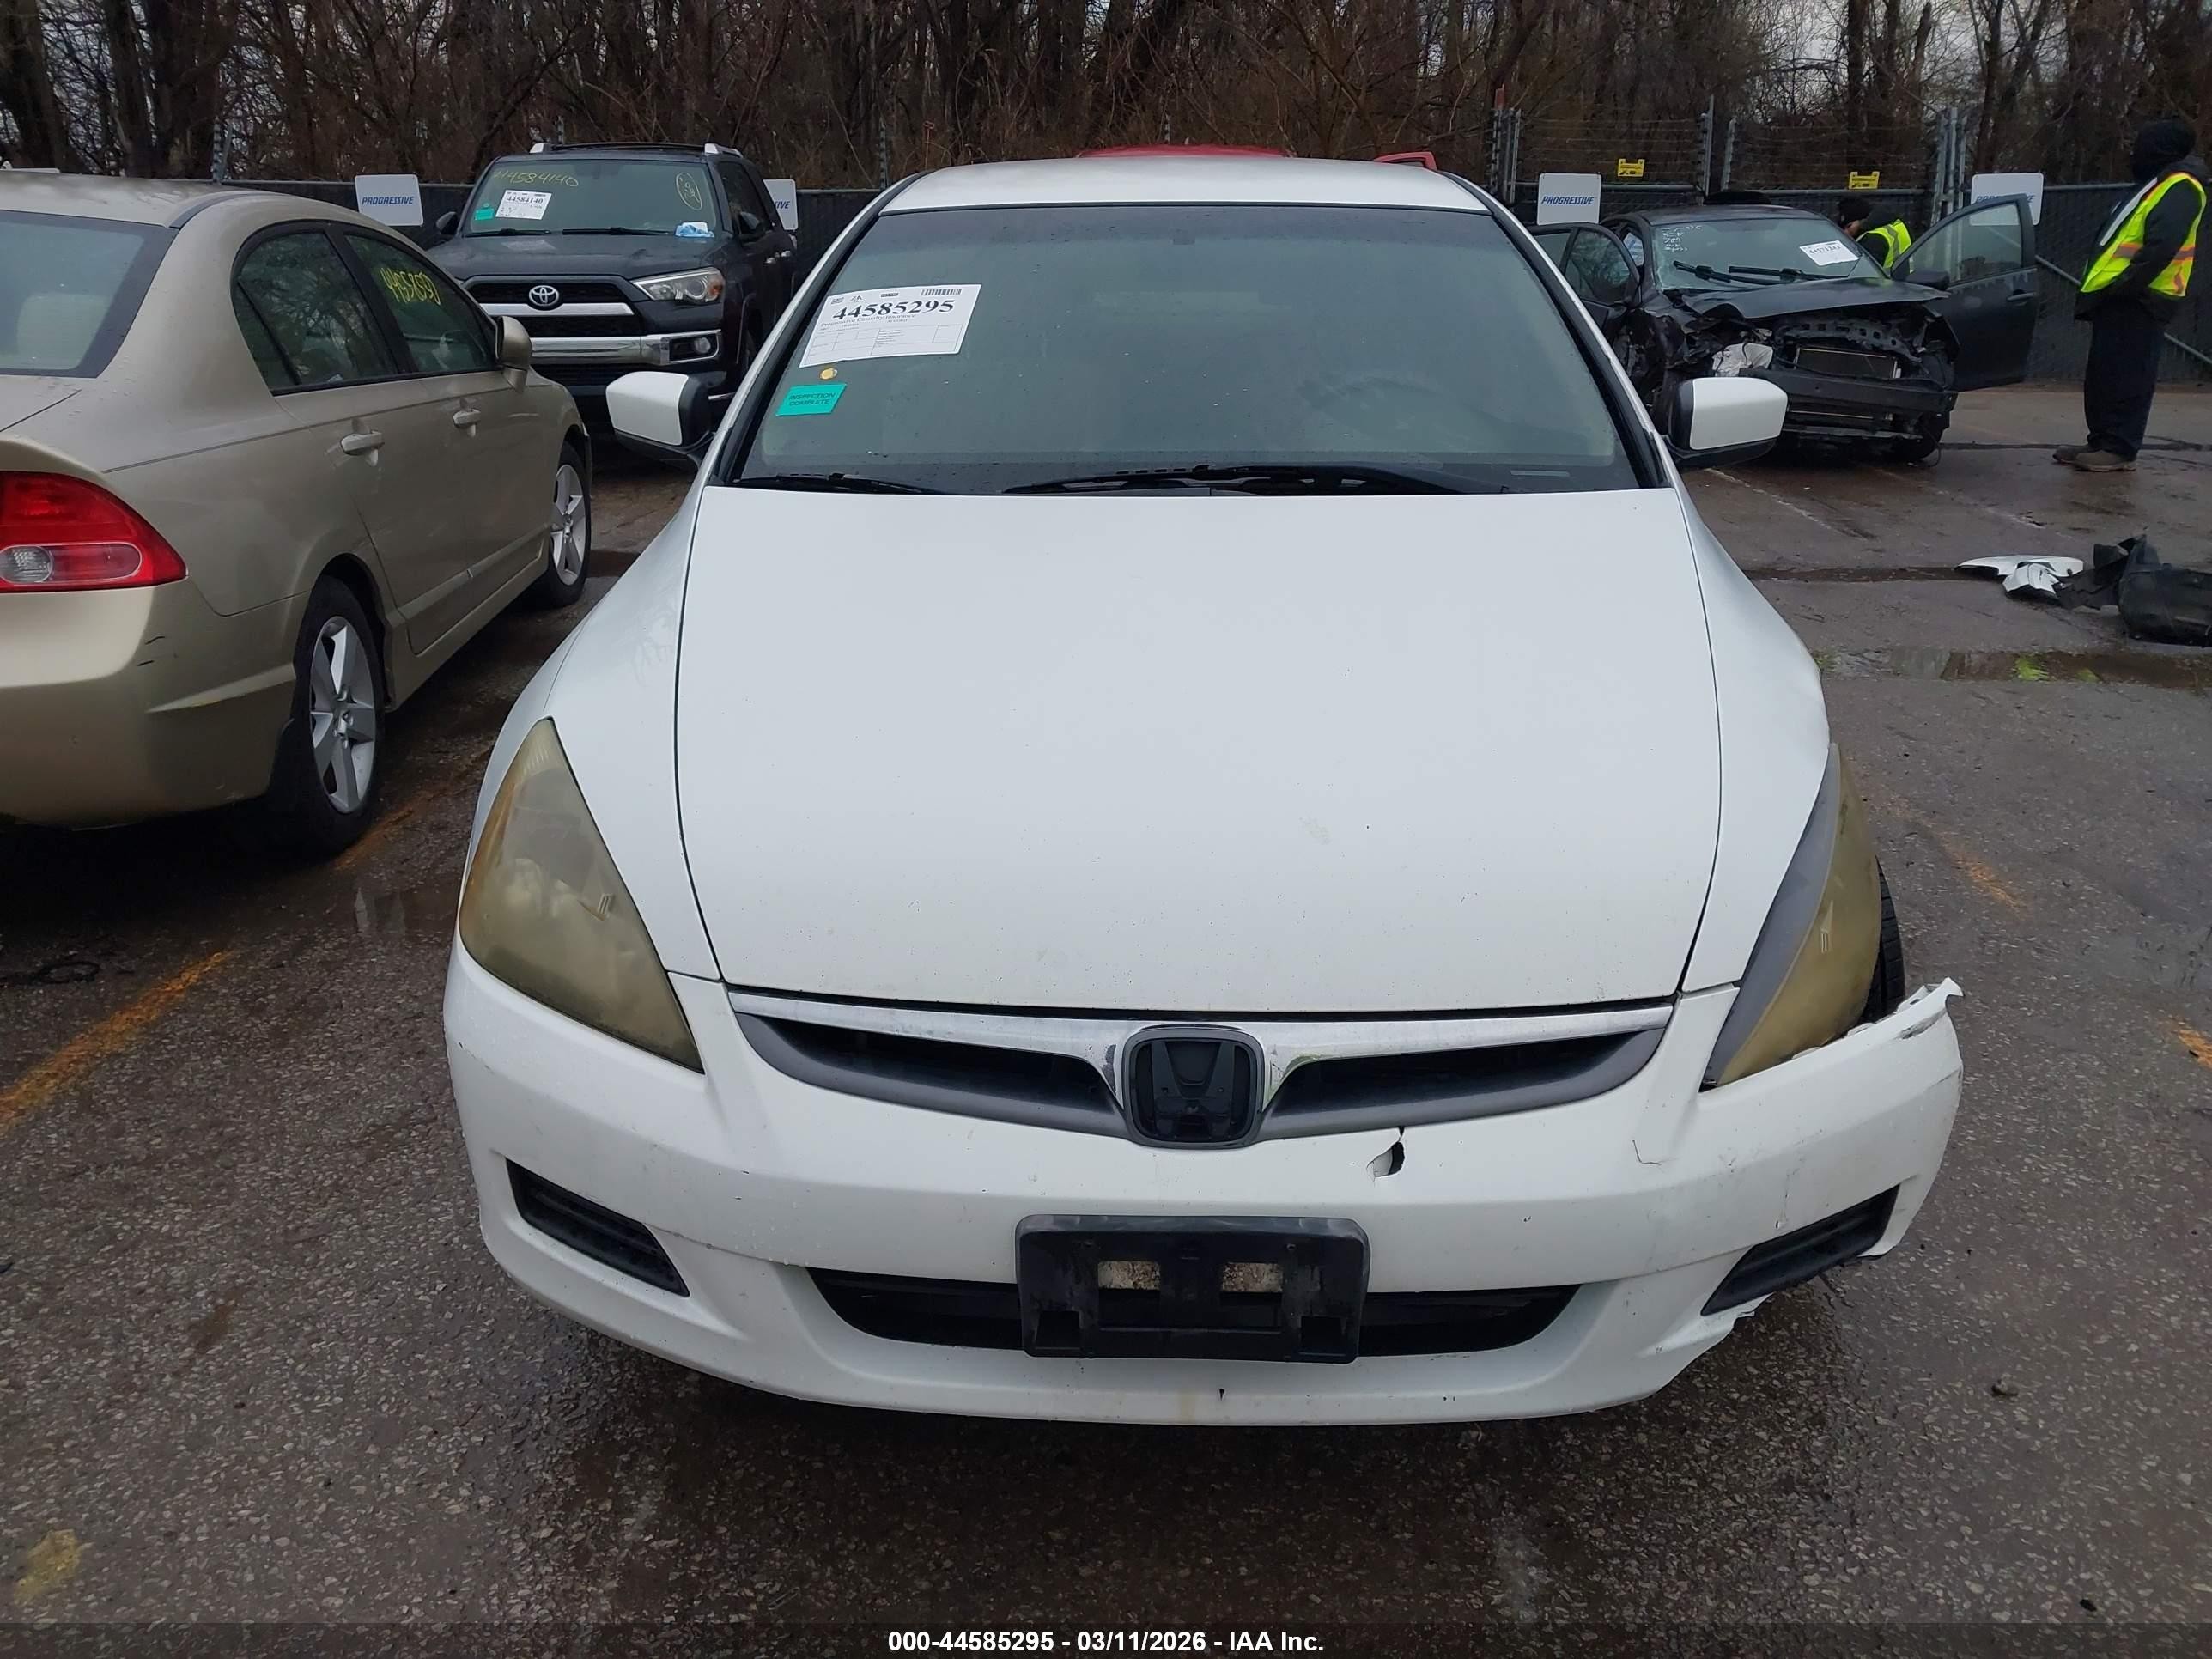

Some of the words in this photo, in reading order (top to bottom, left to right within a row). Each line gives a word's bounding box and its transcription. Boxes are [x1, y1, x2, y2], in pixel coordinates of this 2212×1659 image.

[362, 196, 415, 205] PROGRESSIVE
[1541, 196, 1595, 205] PROGRESSIVE
[833, 300, 956, 320] 44585295
